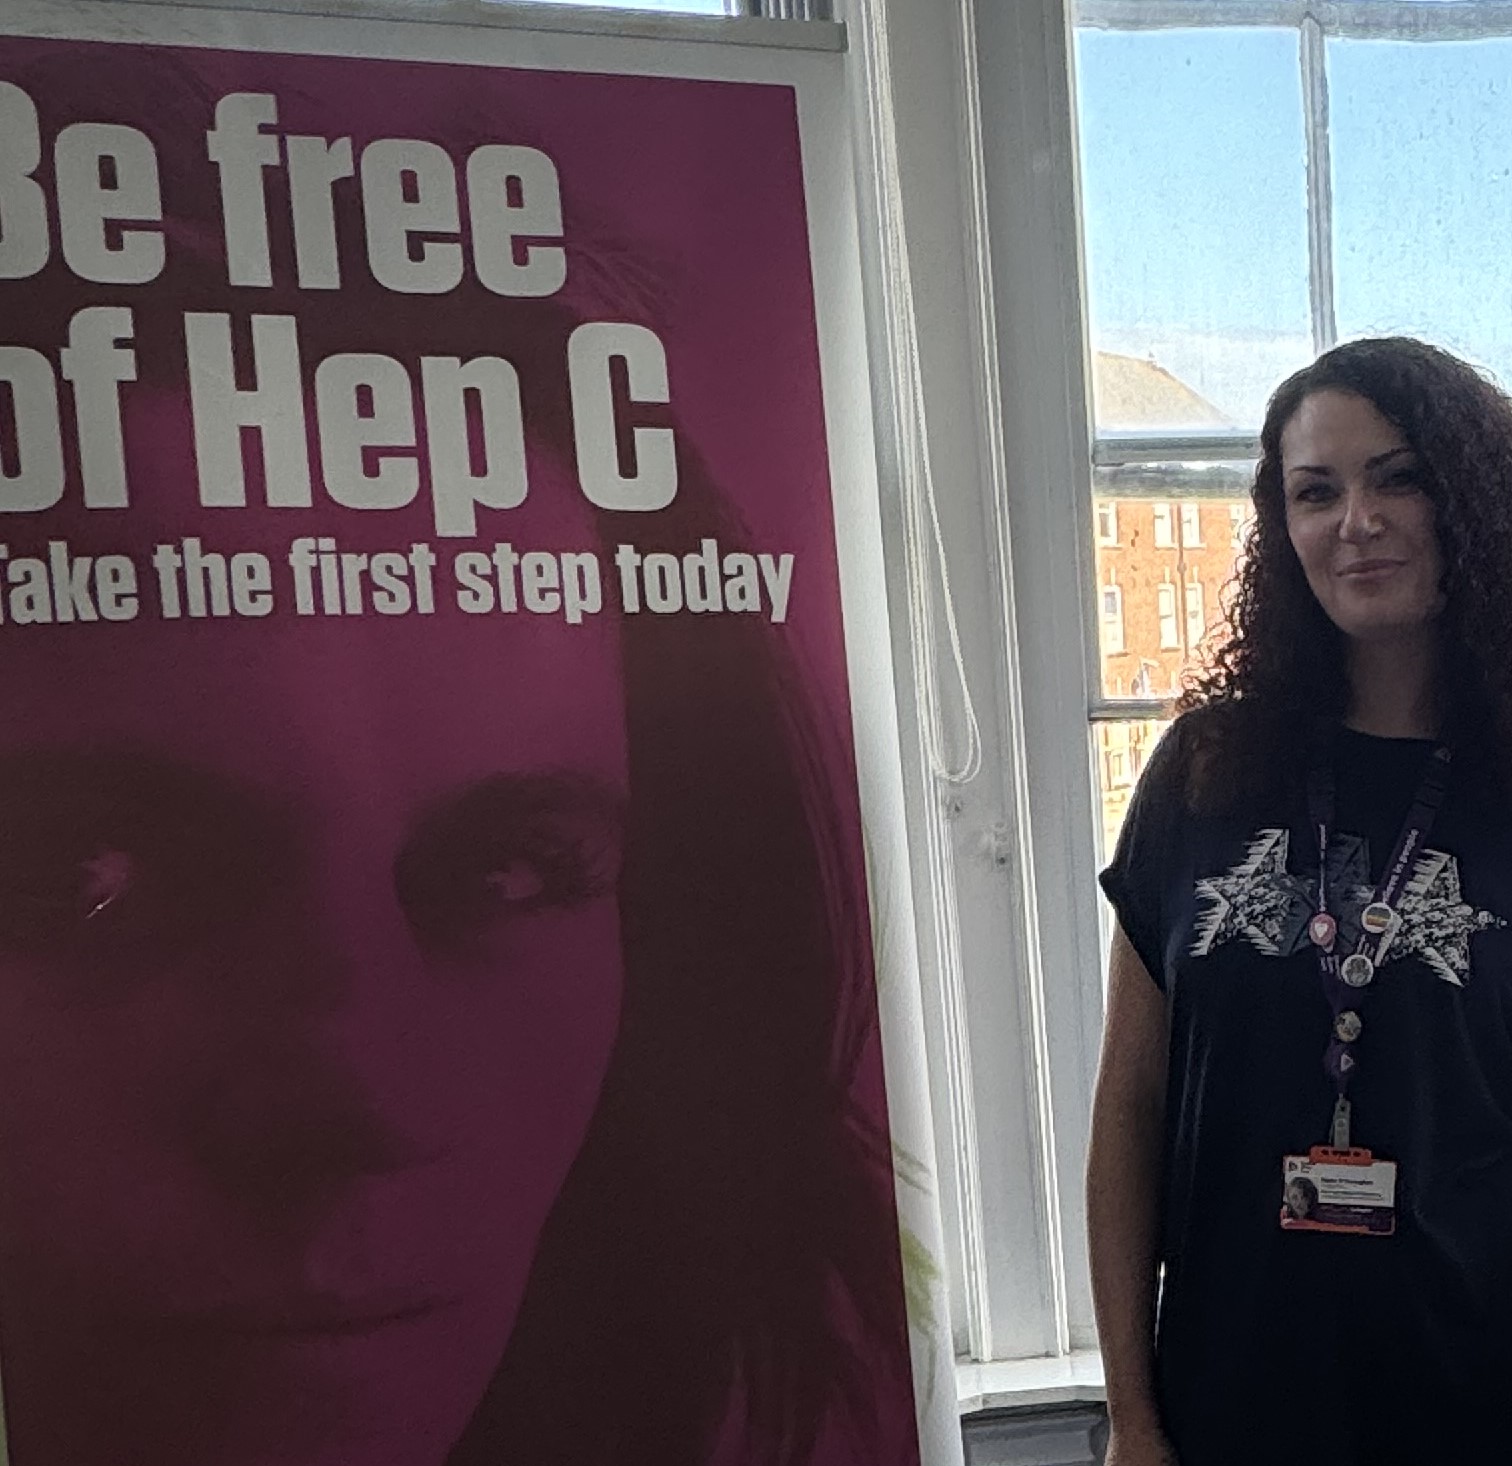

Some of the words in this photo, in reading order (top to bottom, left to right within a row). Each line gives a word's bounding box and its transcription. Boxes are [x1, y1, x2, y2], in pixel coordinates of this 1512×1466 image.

[207, 92, 567, 298] free
[0, 307, 136, 512] of
[184, 312, 528, 538] Hep
[567, 322, 679, 512] C
[0, 540, 139, 625] ake
[153, 537, 272, 620] the
[290, 537, 436, 617] first
[456, 542, 602, 624] step
[616, 539, 795, 623] today
